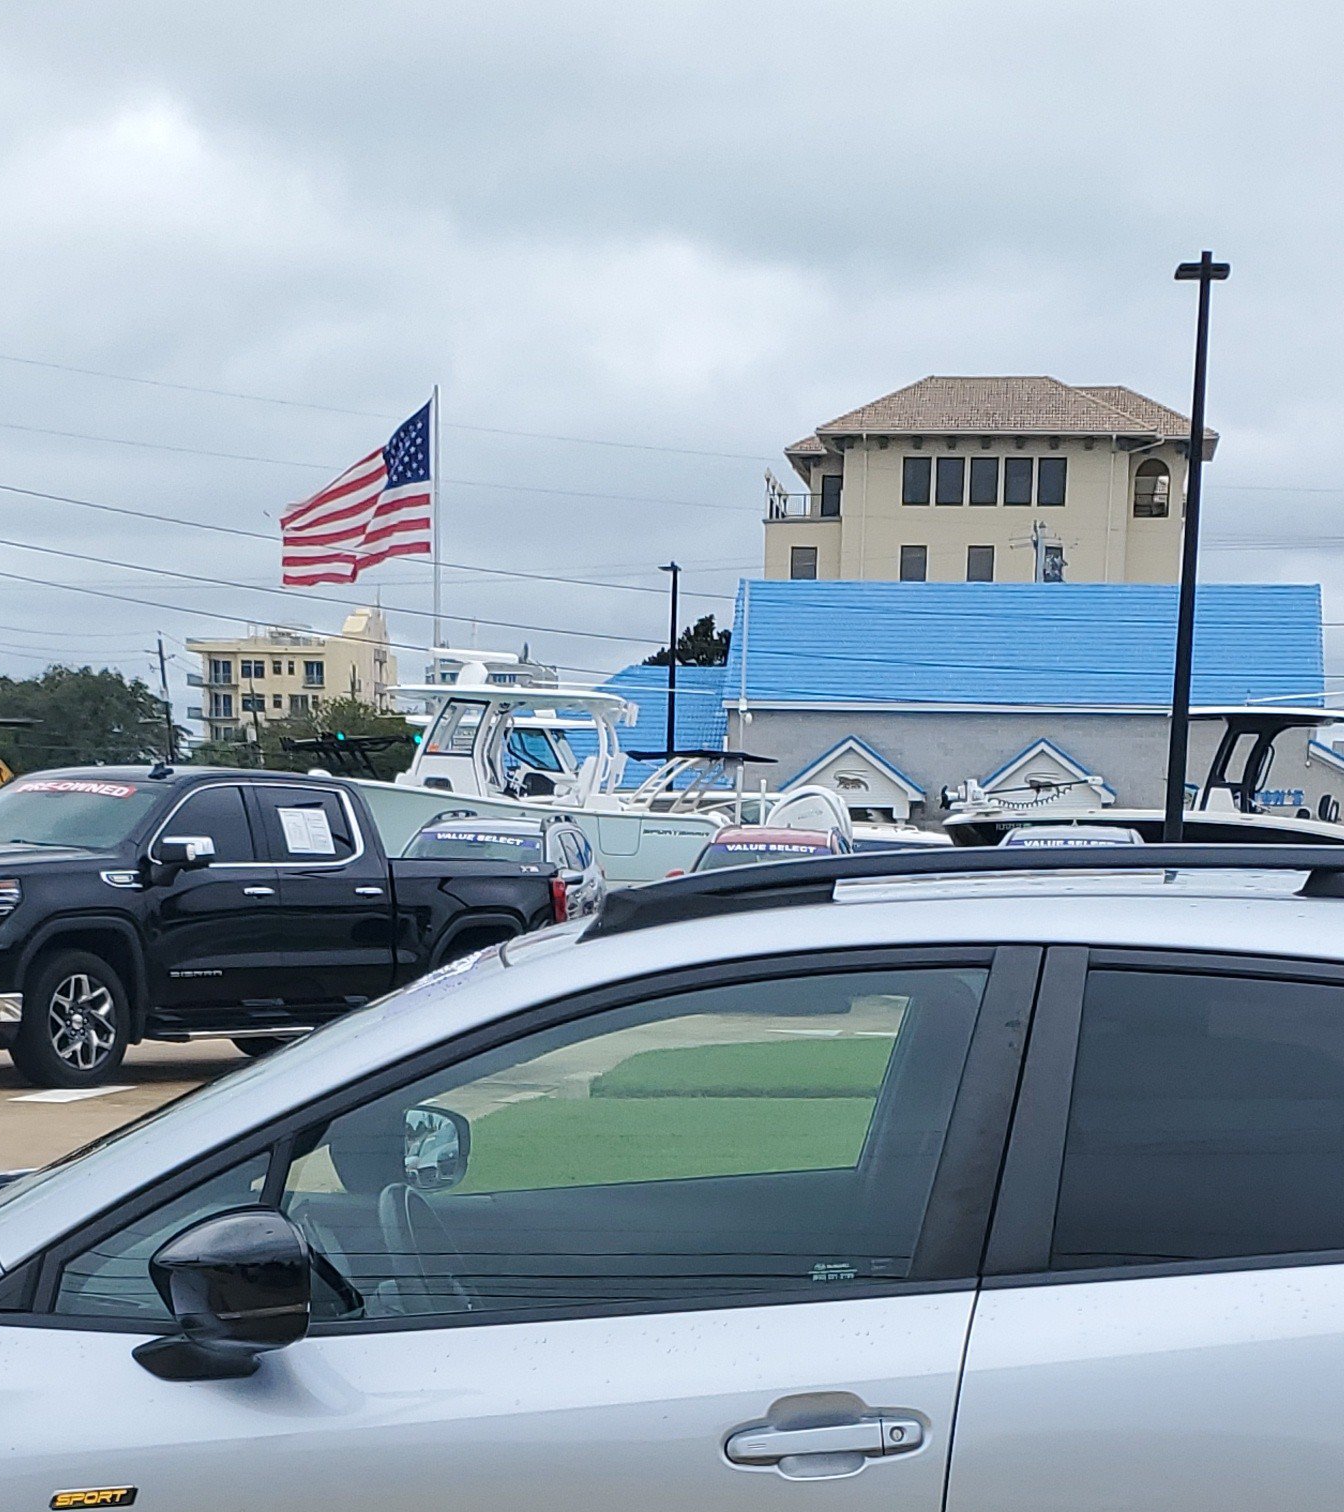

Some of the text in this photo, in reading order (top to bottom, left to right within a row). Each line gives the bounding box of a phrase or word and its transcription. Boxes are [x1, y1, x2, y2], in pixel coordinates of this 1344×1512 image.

[16, 782, 130, 798] PRE-OWNED
[437, 832, 524, 846] VALUE SELECT
[726, 844, 816, 854] VALUE SELECT
[55, 1489, 128, 1507] SPORT
